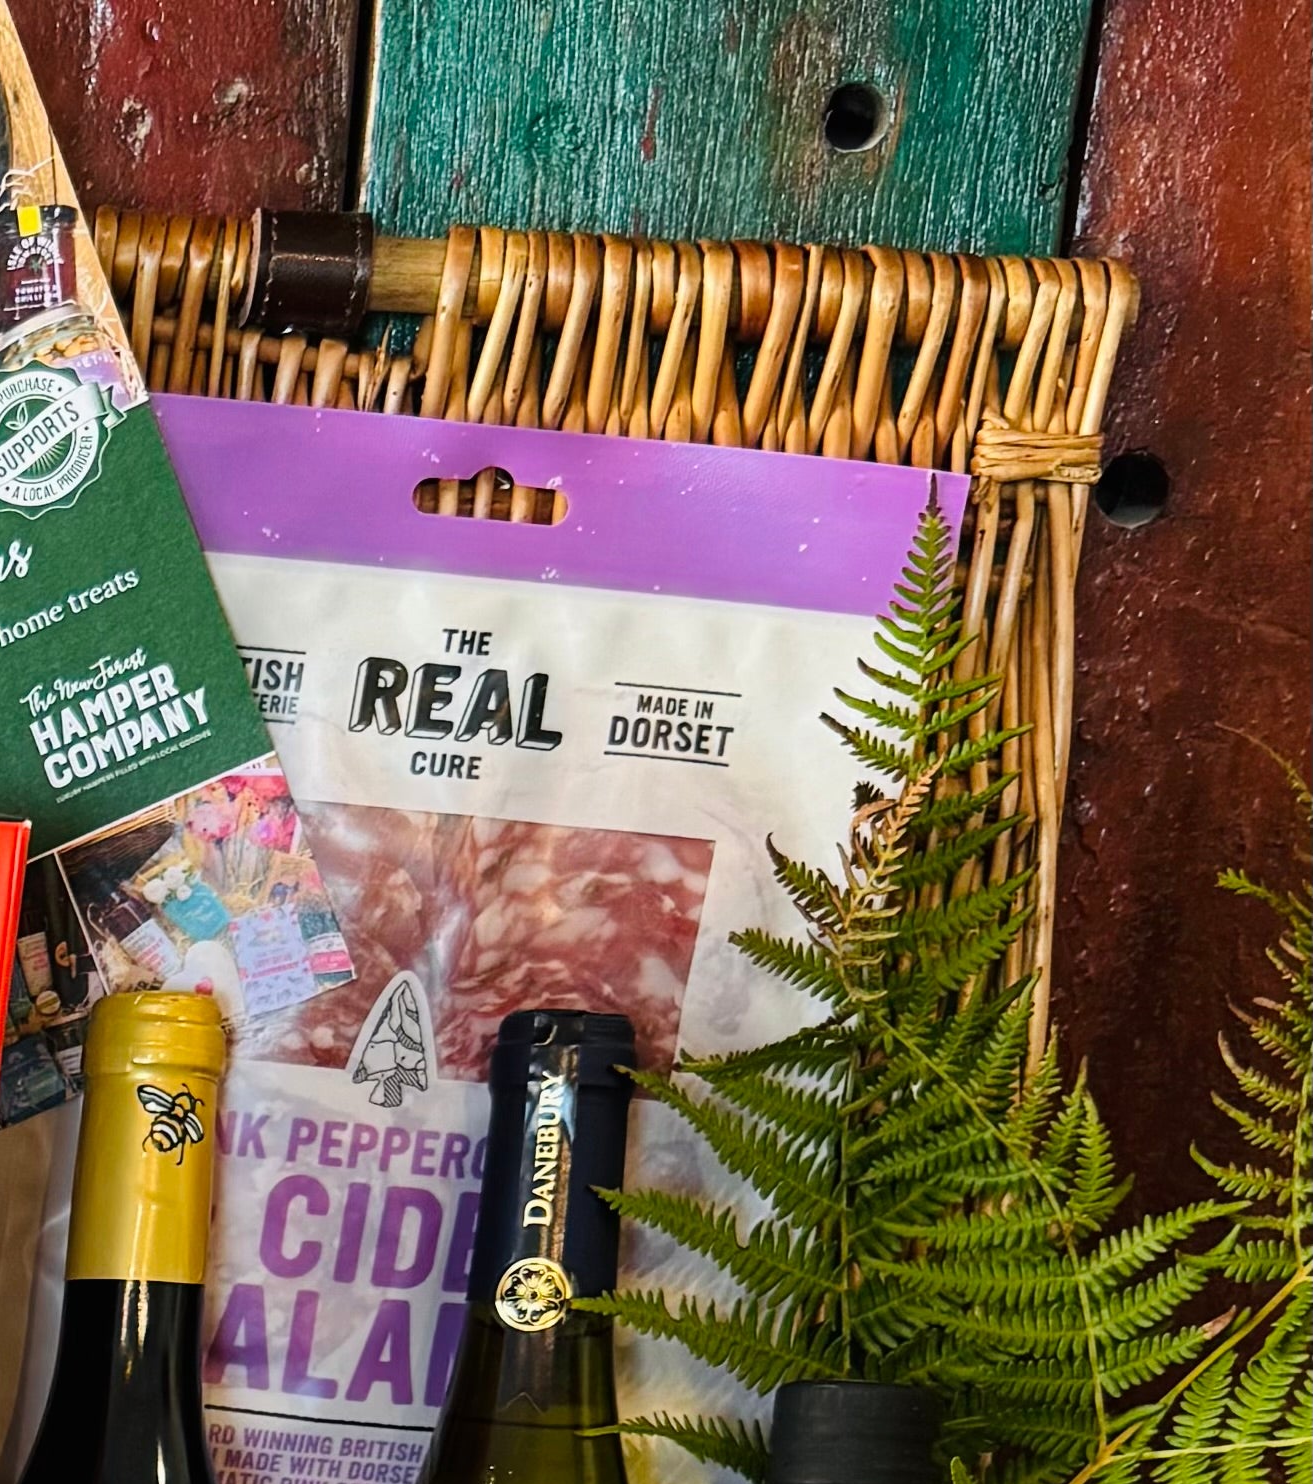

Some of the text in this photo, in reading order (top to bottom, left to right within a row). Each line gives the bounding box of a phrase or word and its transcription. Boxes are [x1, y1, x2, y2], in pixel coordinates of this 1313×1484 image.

[67, 569, 139, 613] treats
[442, 628, 492, 656] THE
[29, 663, 179, 755] HAMPER
[348, 656, 562, 751] REAL
[42, 688, 212, 790] COMPANY
[608, 716, 734, 757] DORSET
[409, 751, 482, 780] CURE
[523, 1072, 566, 1227] DANEBURY
[244, 1428, 333, 1455] WINNING
